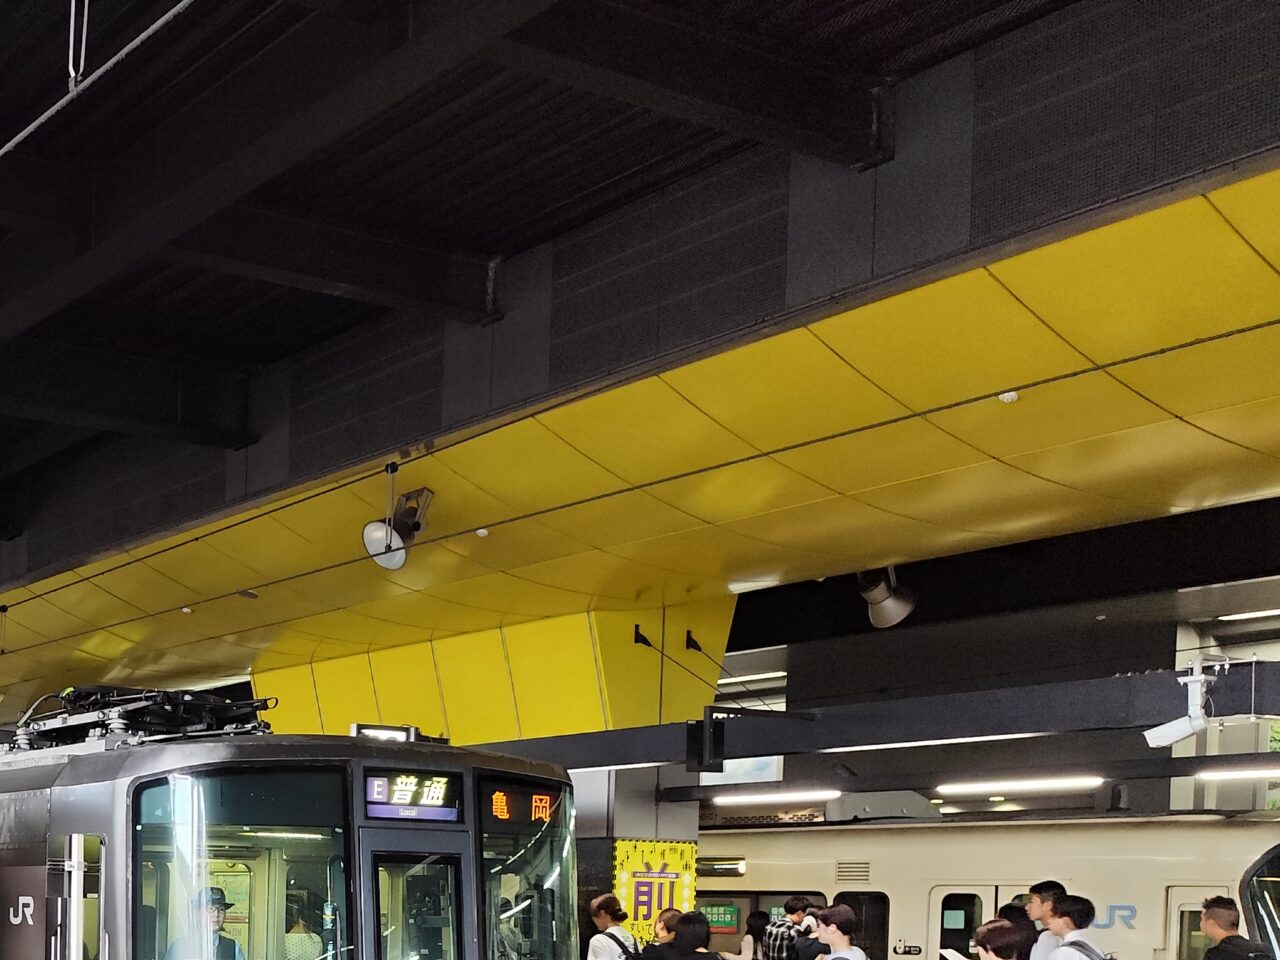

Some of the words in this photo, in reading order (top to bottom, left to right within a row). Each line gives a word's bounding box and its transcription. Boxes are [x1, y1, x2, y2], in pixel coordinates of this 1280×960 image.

[372, 780, 383, 799] E
[390, 775, 448, 806] 普通
[492, 791, 551, 822] 亀岡
[631, 861, 679, 921] 前
[9, 896, 34, 925] JR
[1091, 905, 1136, 930] JR
